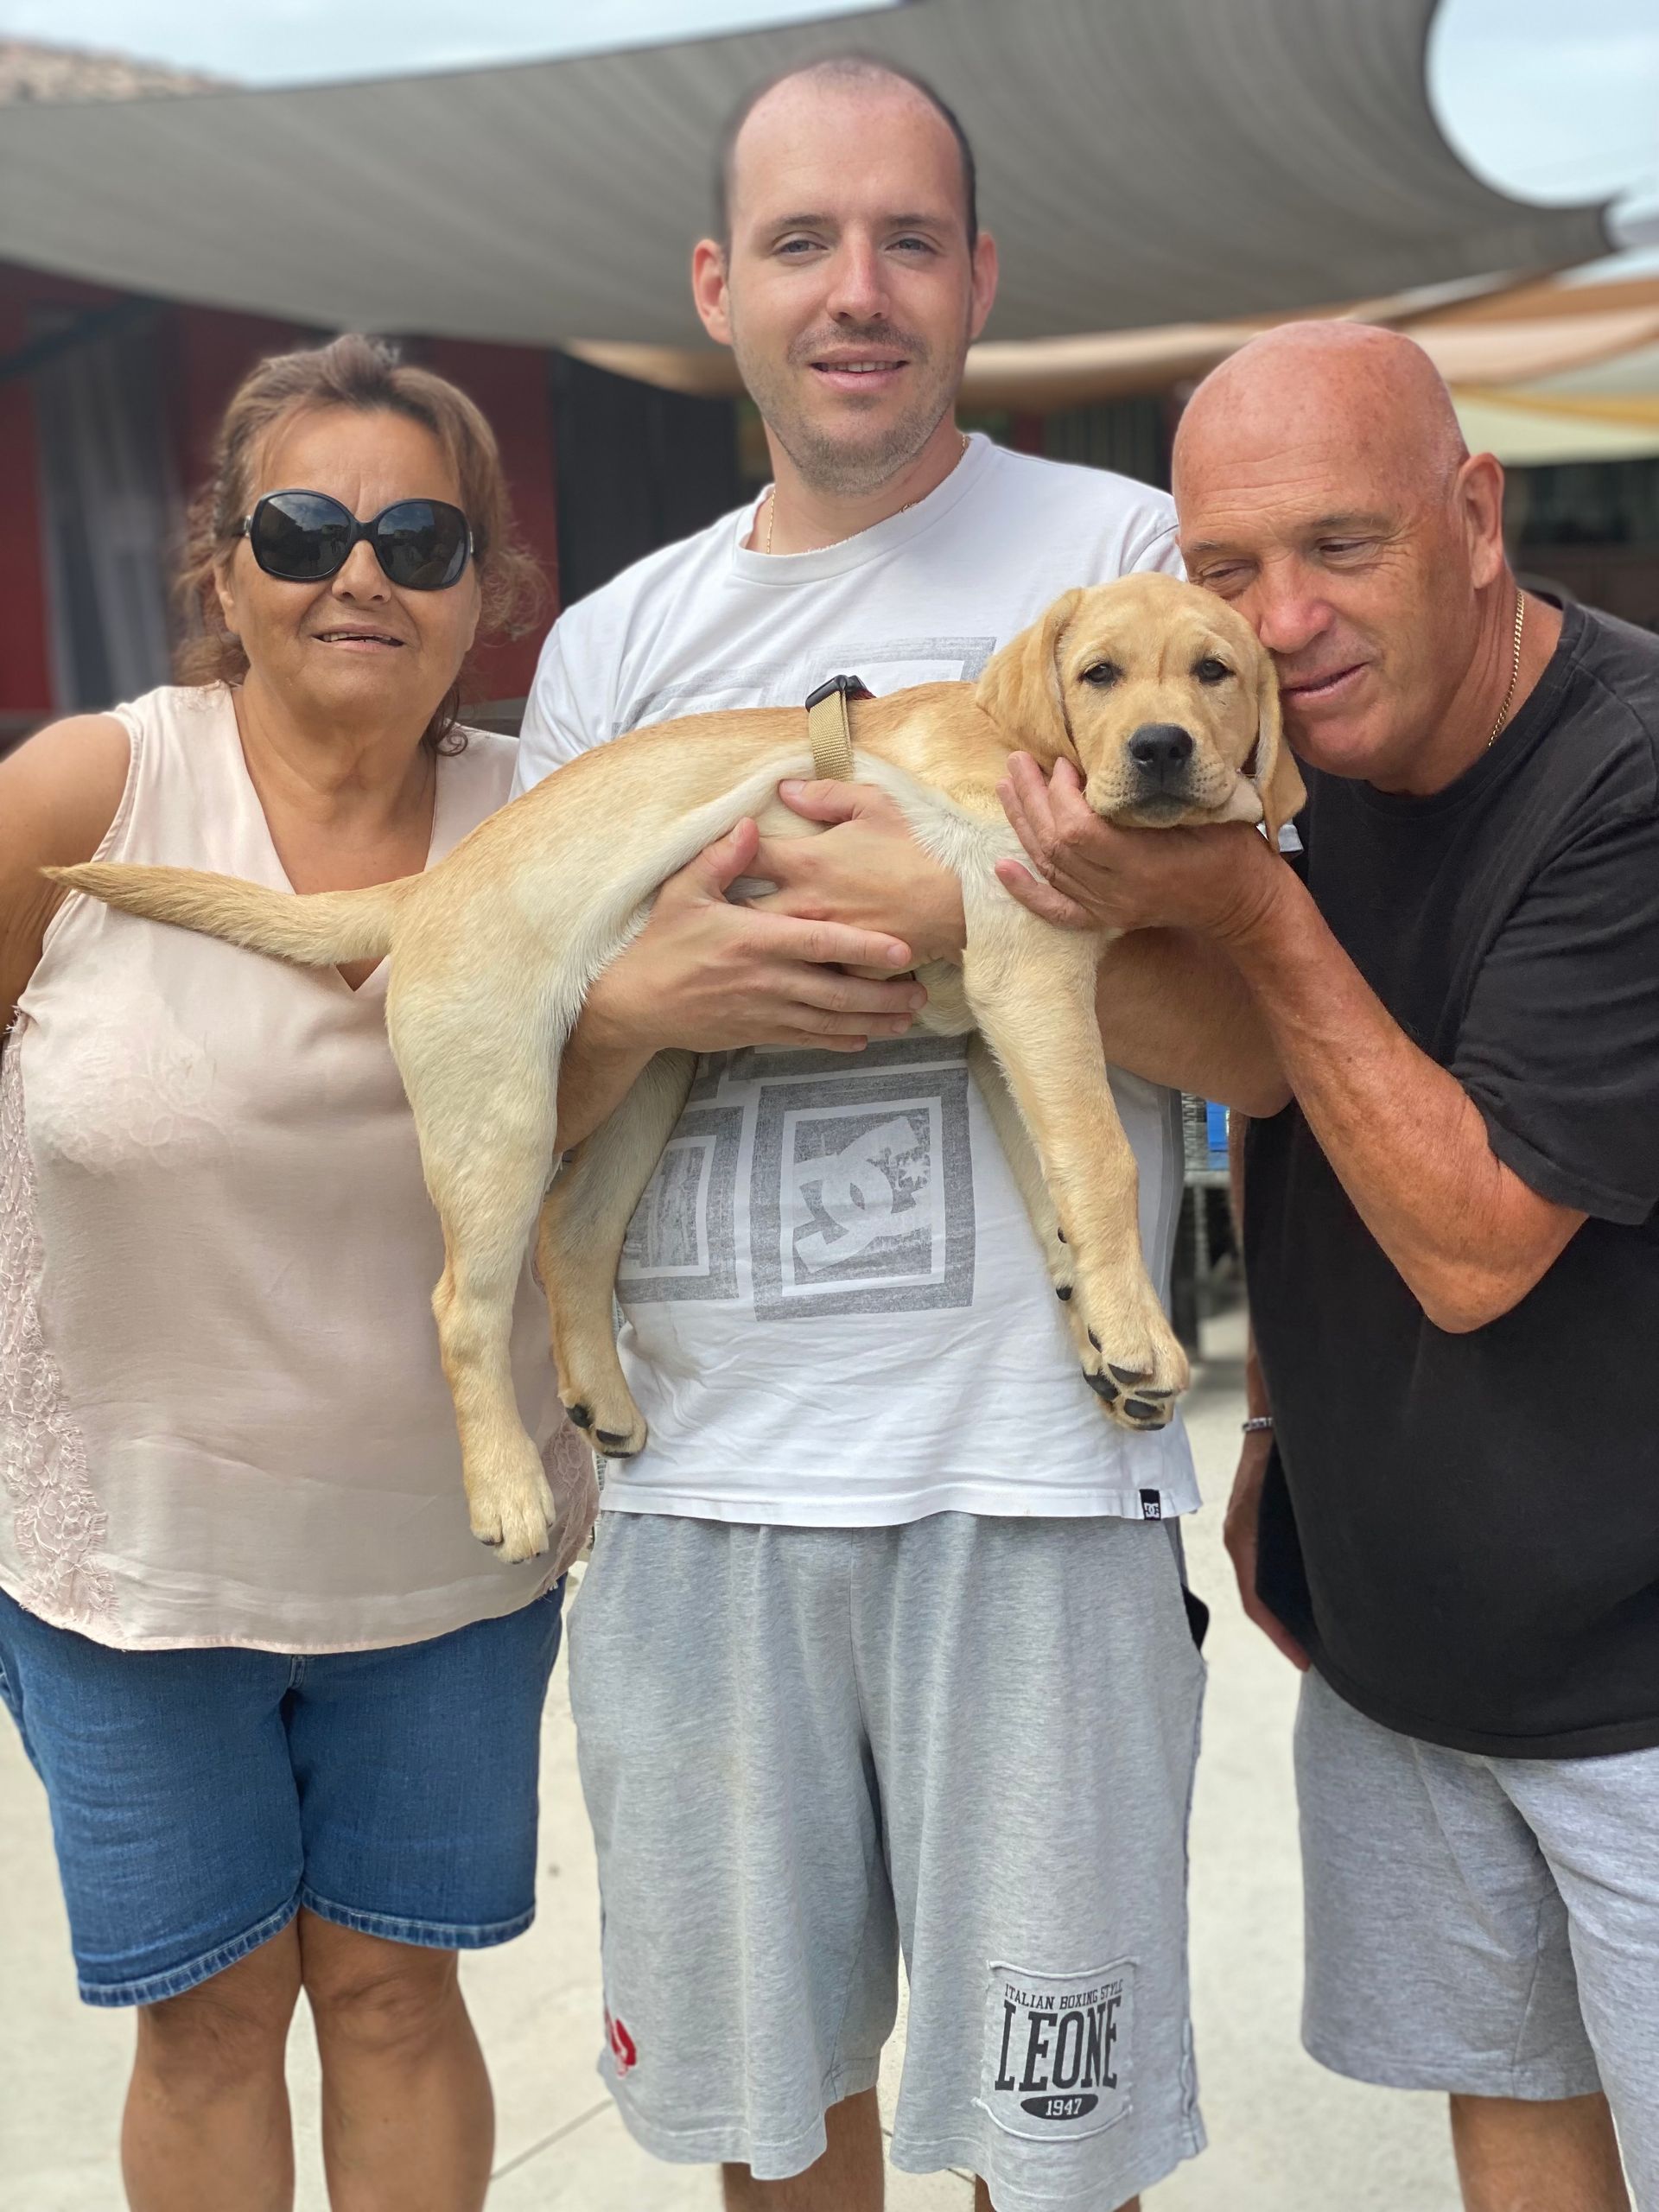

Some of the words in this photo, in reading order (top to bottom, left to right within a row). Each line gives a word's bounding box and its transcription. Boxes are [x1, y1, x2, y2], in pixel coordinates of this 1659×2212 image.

[1005, 1984, 1055, 2010] ITALIAN
[1059, 1989, 1098, 2010] BOXING
[1100, 1979, 1123, 2000] STYLE
[995, 1996, 1122, 2091] LEONE
[1046, 2098, 1082, 2116] 1947
